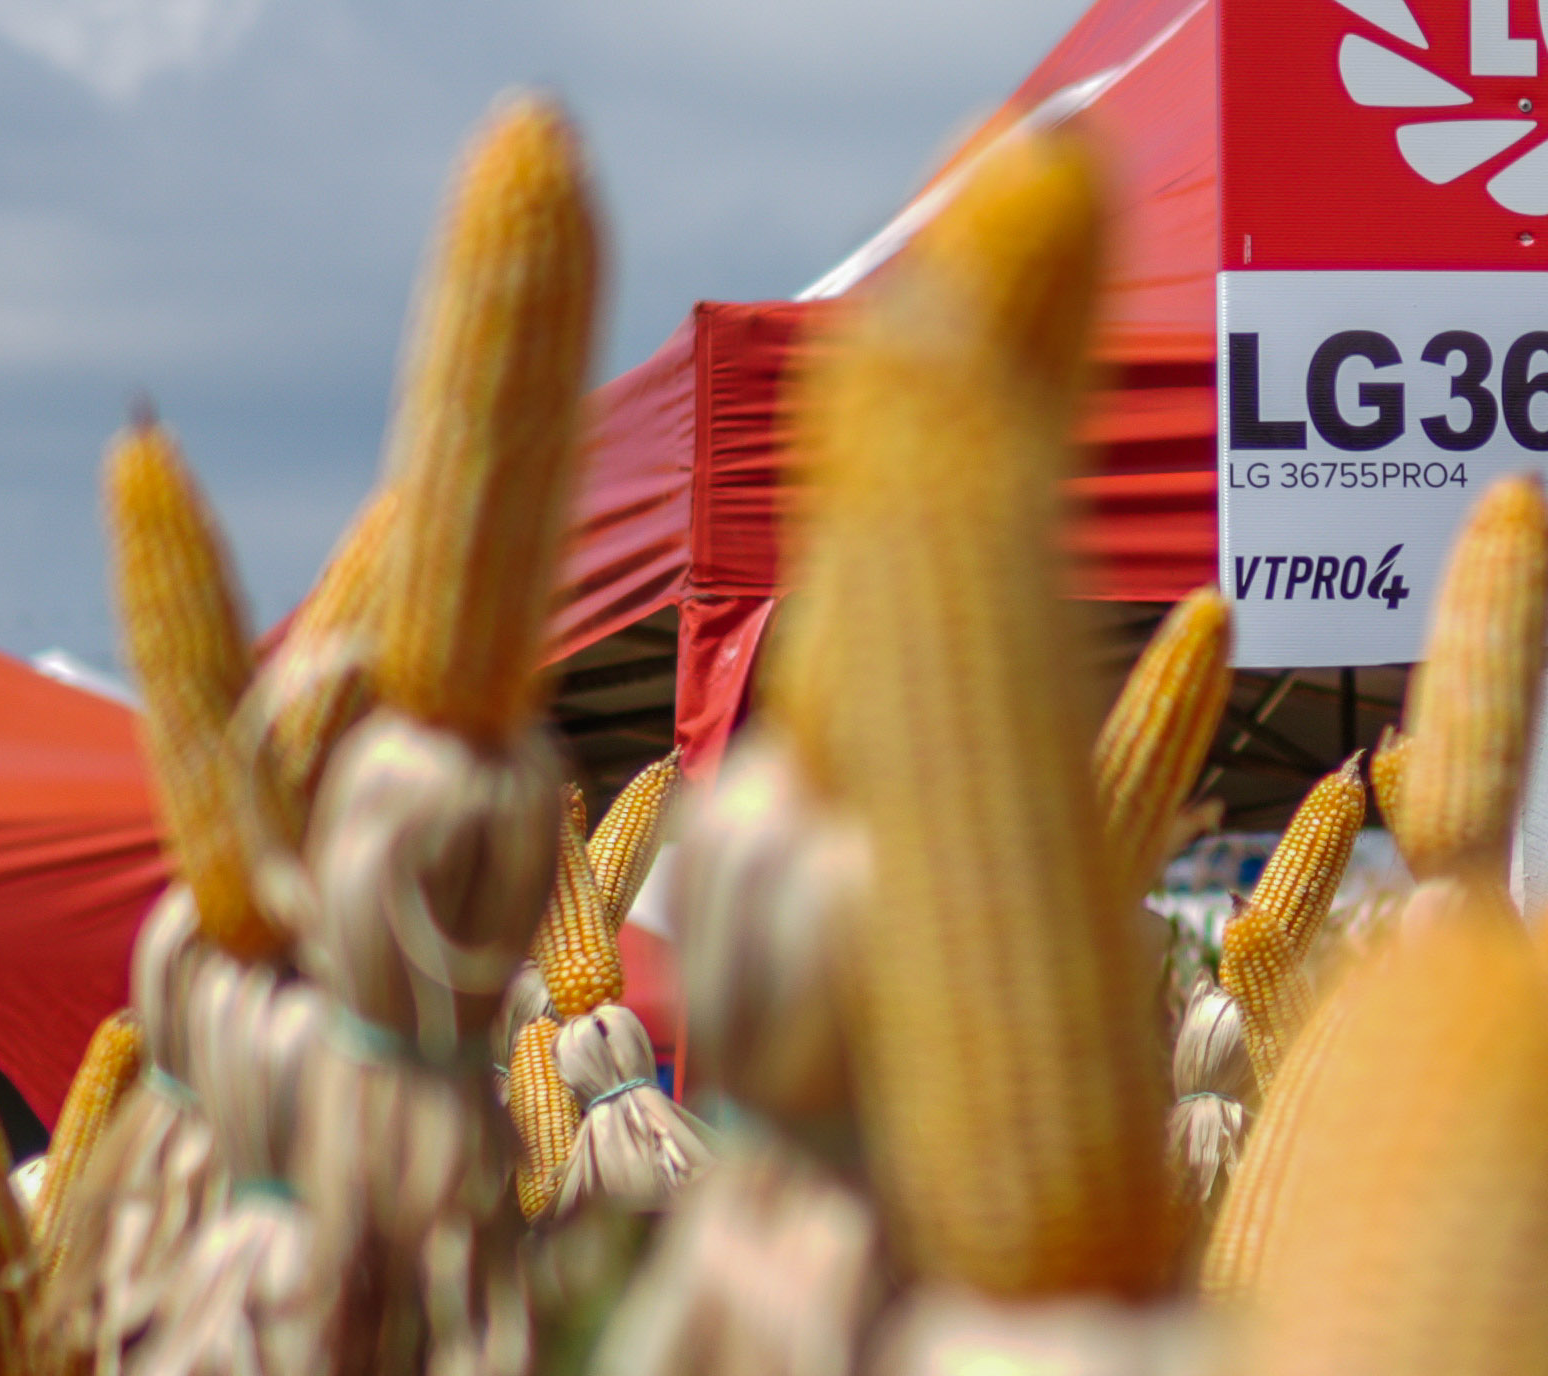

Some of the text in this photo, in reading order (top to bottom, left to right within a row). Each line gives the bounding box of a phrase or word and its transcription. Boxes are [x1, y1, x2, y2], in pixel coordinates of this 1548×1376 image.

[1229, 462, 1469, 489] LG 36755PRO4
[1234, 543, 1411, 610] VTPRO4
